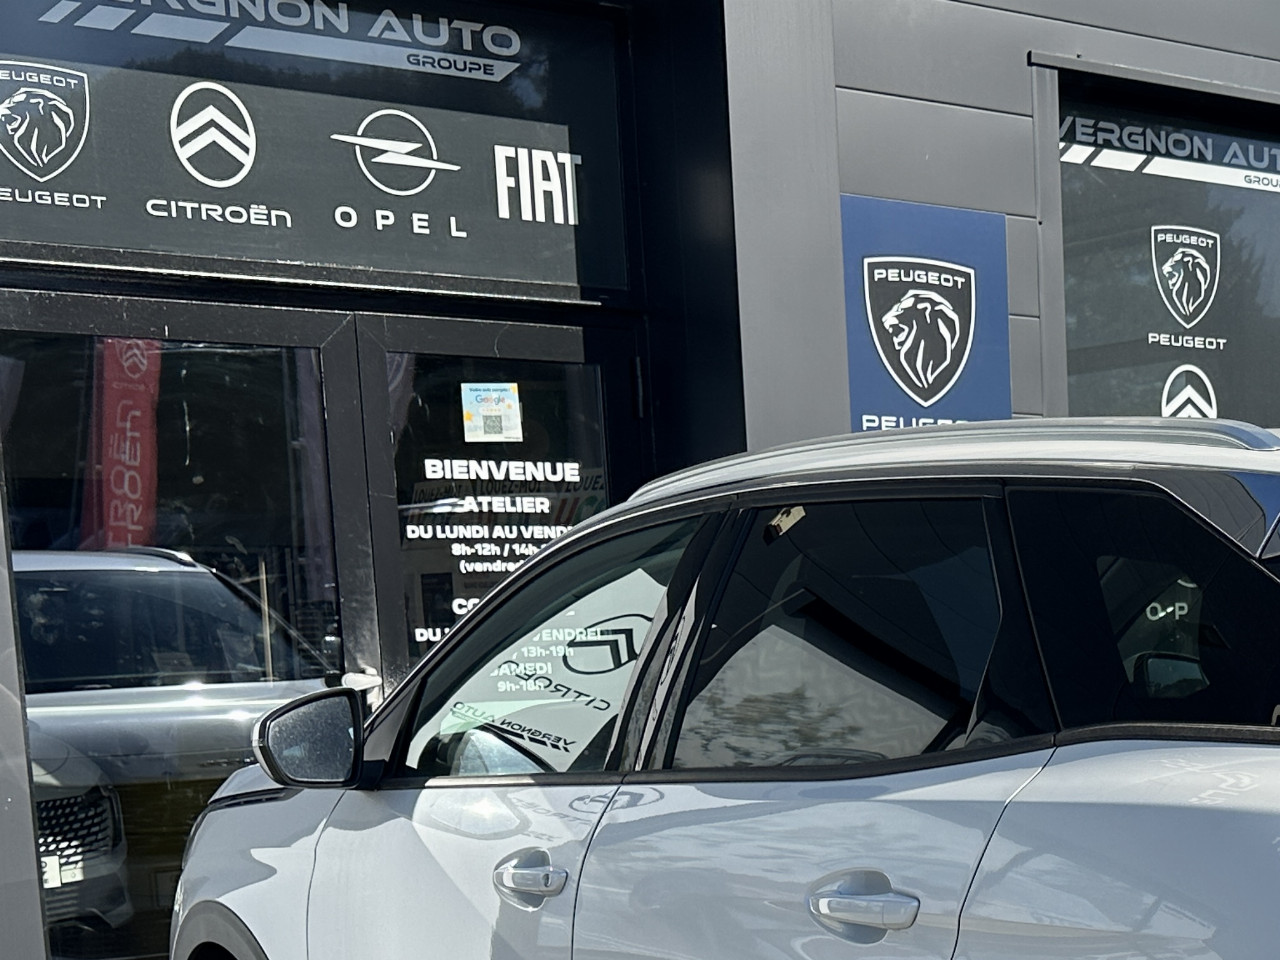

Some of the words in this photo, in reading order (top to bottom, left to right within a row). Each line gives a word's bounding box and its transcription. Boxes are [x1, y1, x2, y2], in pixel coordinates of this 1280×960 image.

[367, 9, 521, 56] AUTO
[406, 53, 495, 76] GROUPE
[0, 70, 78, 88] EUGEOT
[494, 144, 582, 226] FIAT
[0, 187, 107, 209] EUGEOT
[334, 205, 468, 238] OPEL
[1156, 233, 1215, 249] PEUGEOT
[873, 268, 966, 289] PEUGEOT
[1147, 332, 1227, 350] PEUGEOT
[861, 414, 969, 430] PEUG
[424, 459, 580, 482] BIENVENUE
[463, 496, 550, 513] ATELIER
[406, 525, 433, 539] DU
[436, 525, 489, 539] LUNDI
[492, 525, 518, 539] AU
[519, 525, 575, 539] VEND
[451, 543, 501, 556] 8h-12h
[503, 543, 510, 557] /
[512, 543, 547, 556] 14h-
[414, 628, 442, 641] DU
[521, 646, 574, 658] 13h-19h
